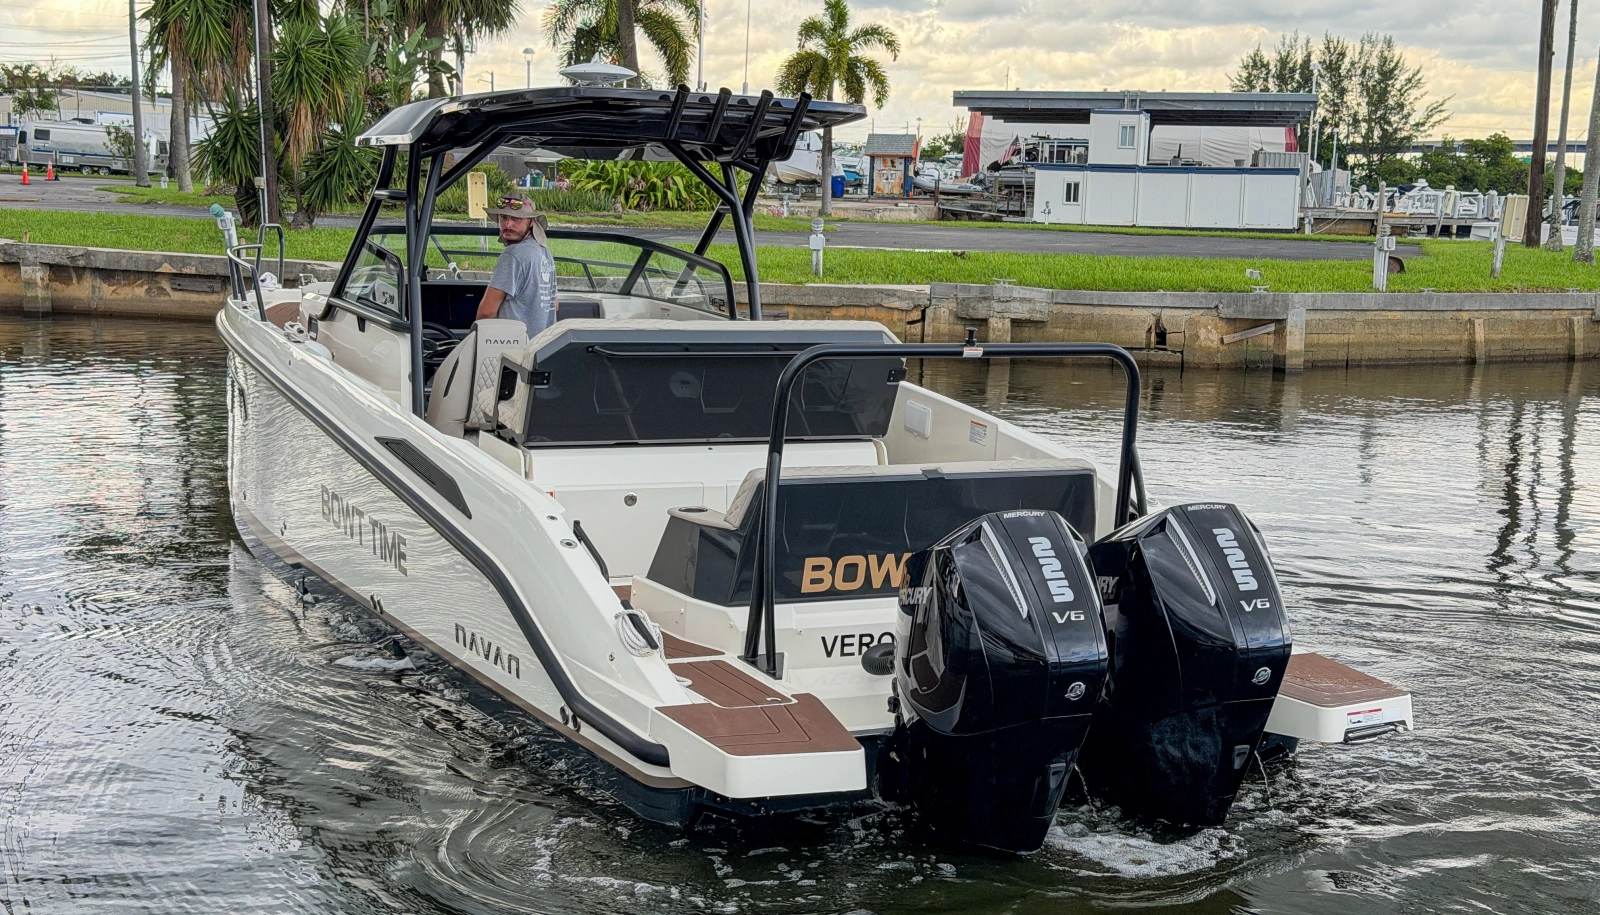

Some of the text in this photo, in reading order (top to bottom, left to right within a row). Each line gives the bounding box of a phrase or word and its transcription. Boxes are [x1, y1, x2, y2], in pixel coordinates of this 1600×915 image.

[1003, 511, 1046, 519] MERCURY
[1187, 504, 1227, 512] MERCURY
[321, 483, 408, 577] BOWT TIME
[1211, 528, 1259, 591] 225
[1028, 536, 1075, 603] 225
[1240, 598, 1270, 612] V6
[1052, 610, 1085, 624] V6
